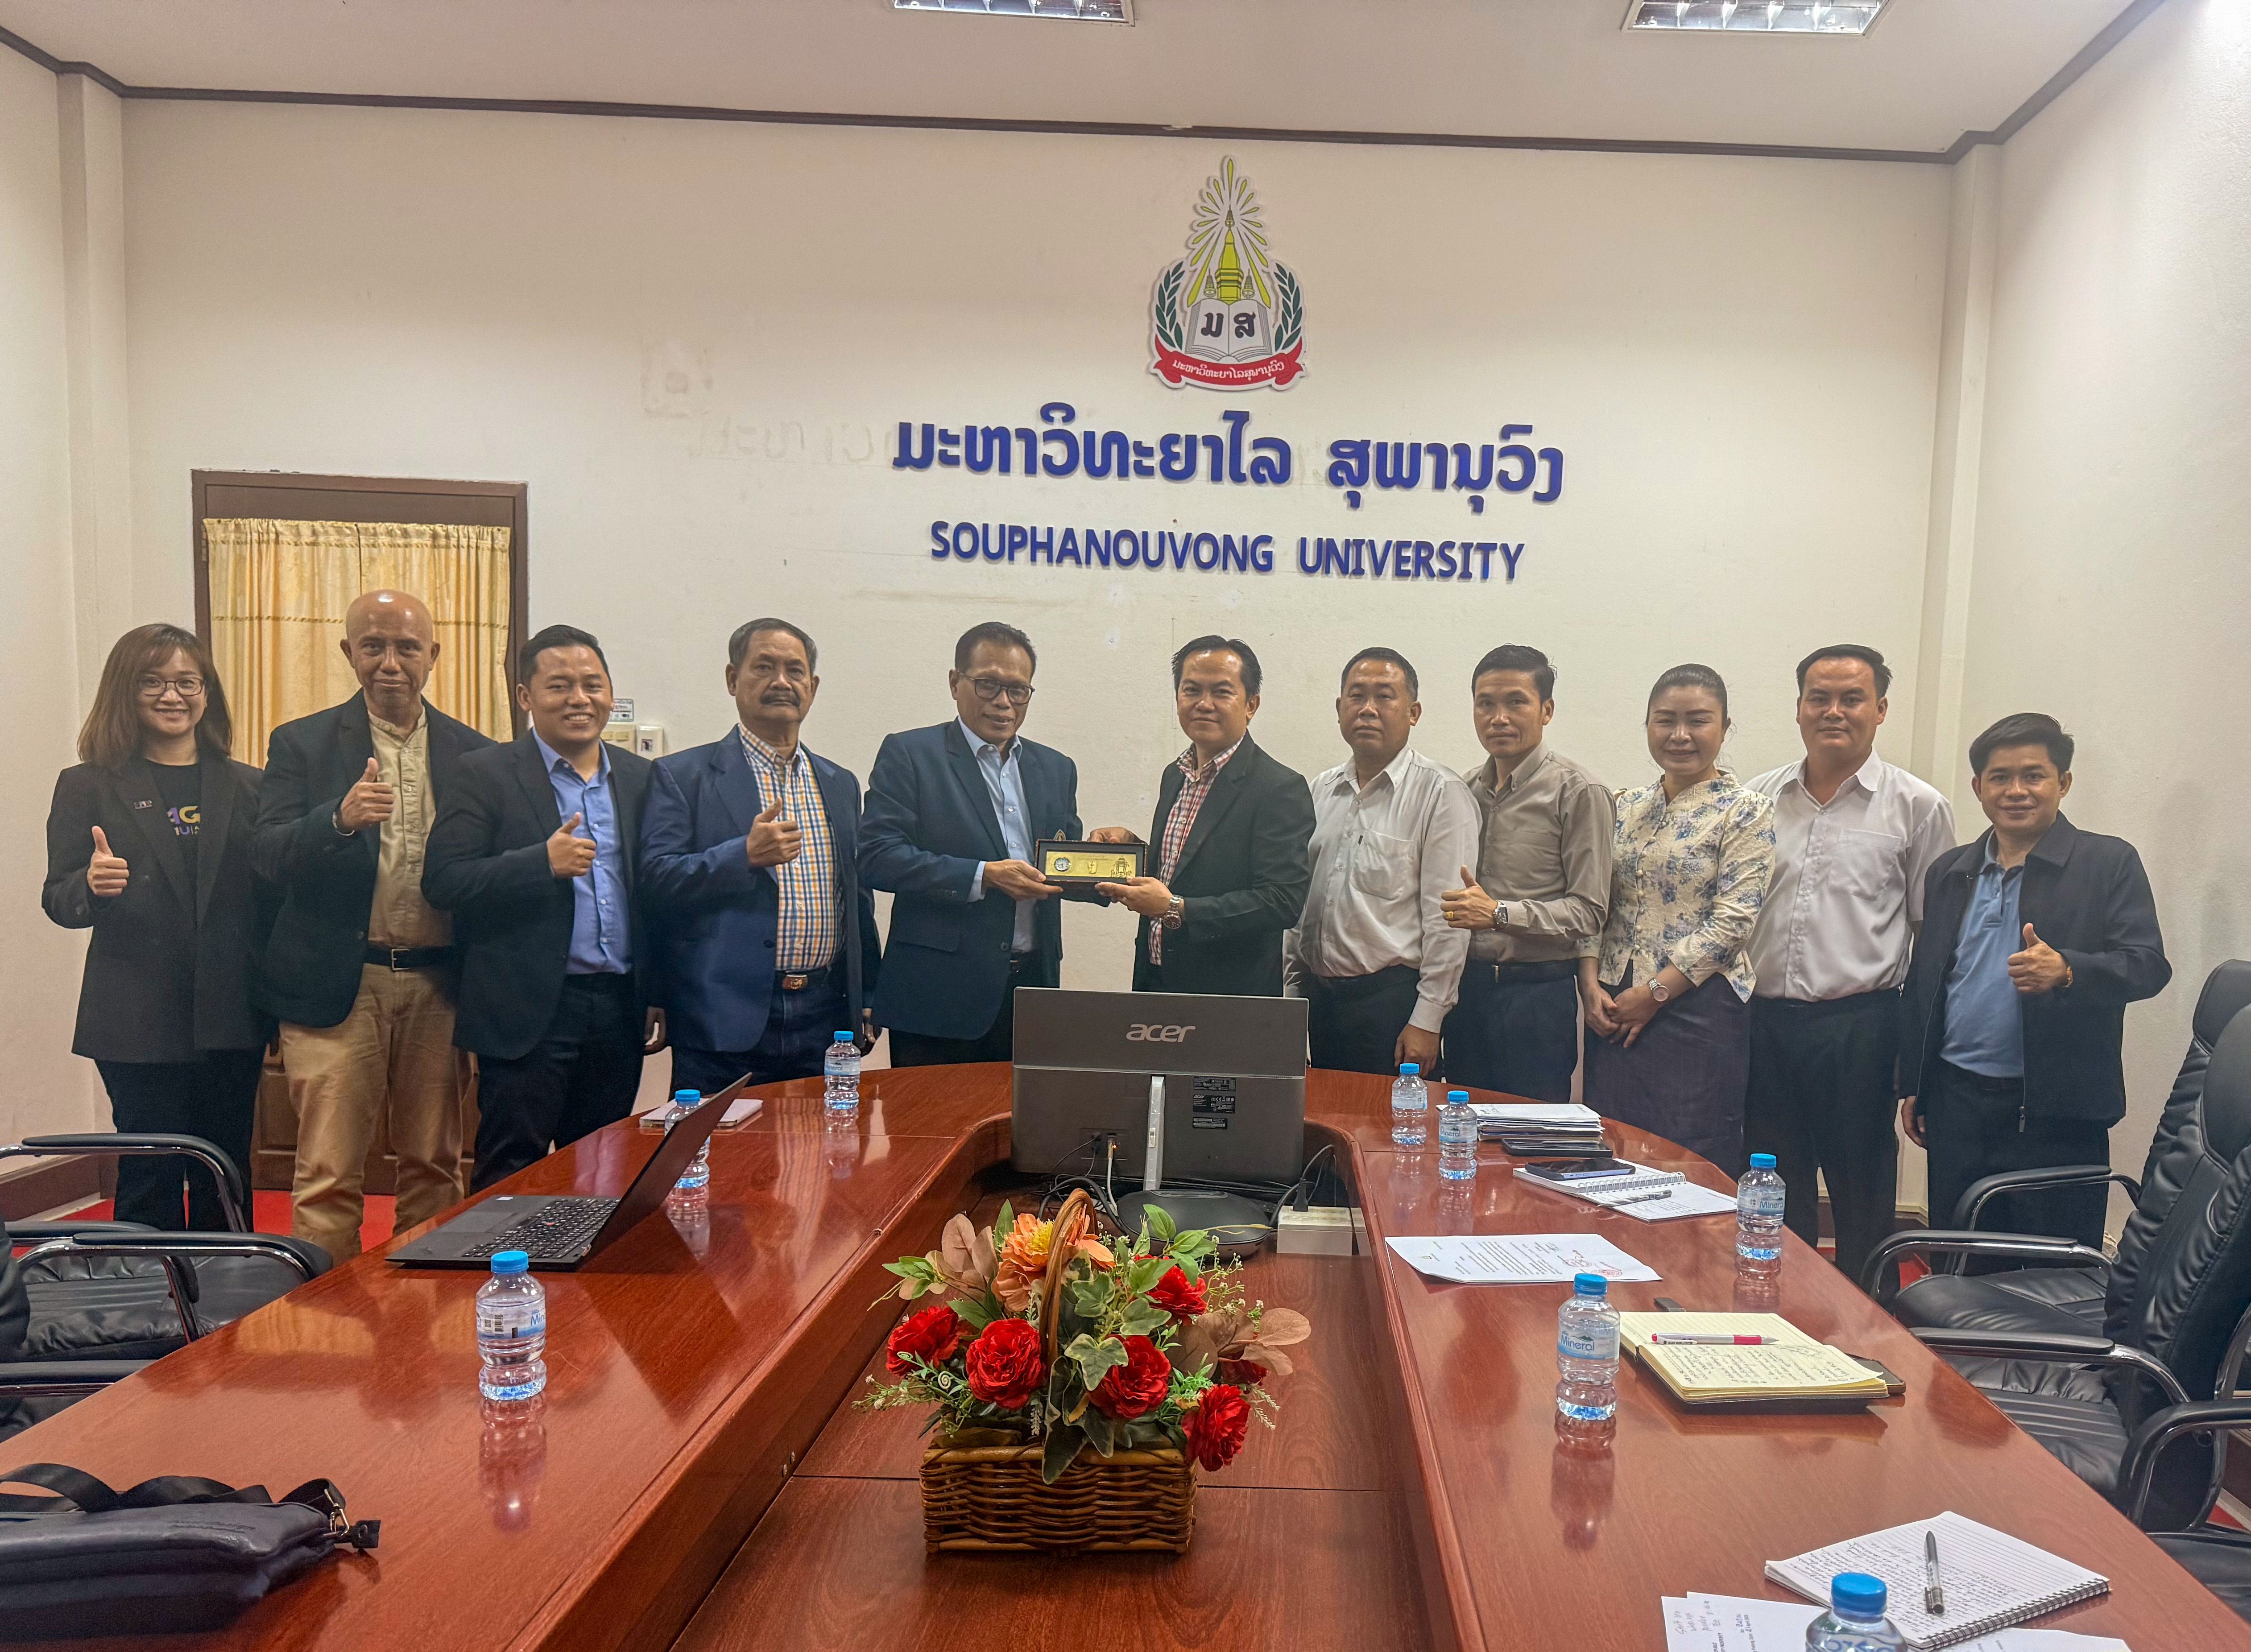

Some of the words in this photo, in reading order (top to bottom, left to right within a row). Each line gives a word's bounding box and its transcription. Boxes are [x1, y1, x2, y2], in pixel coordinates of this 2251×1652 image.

[1201, 312, 1224, 338] ມ
[1233, 311, 1256, 338] ສ
[893, 402, 1291, 484] ມະຫາວິທະຍາໄລ
[1328, 424, 1564, 513] ສຸພານຸວົງ
[931, 520, 1274, 572] SOUPHANOUVONG
[1300, 537, 1525, 579] UNIVERSITY
[1126, 1023, 1196, 1042] acer
[1561, 1334, 1594, 1351] Mineral
